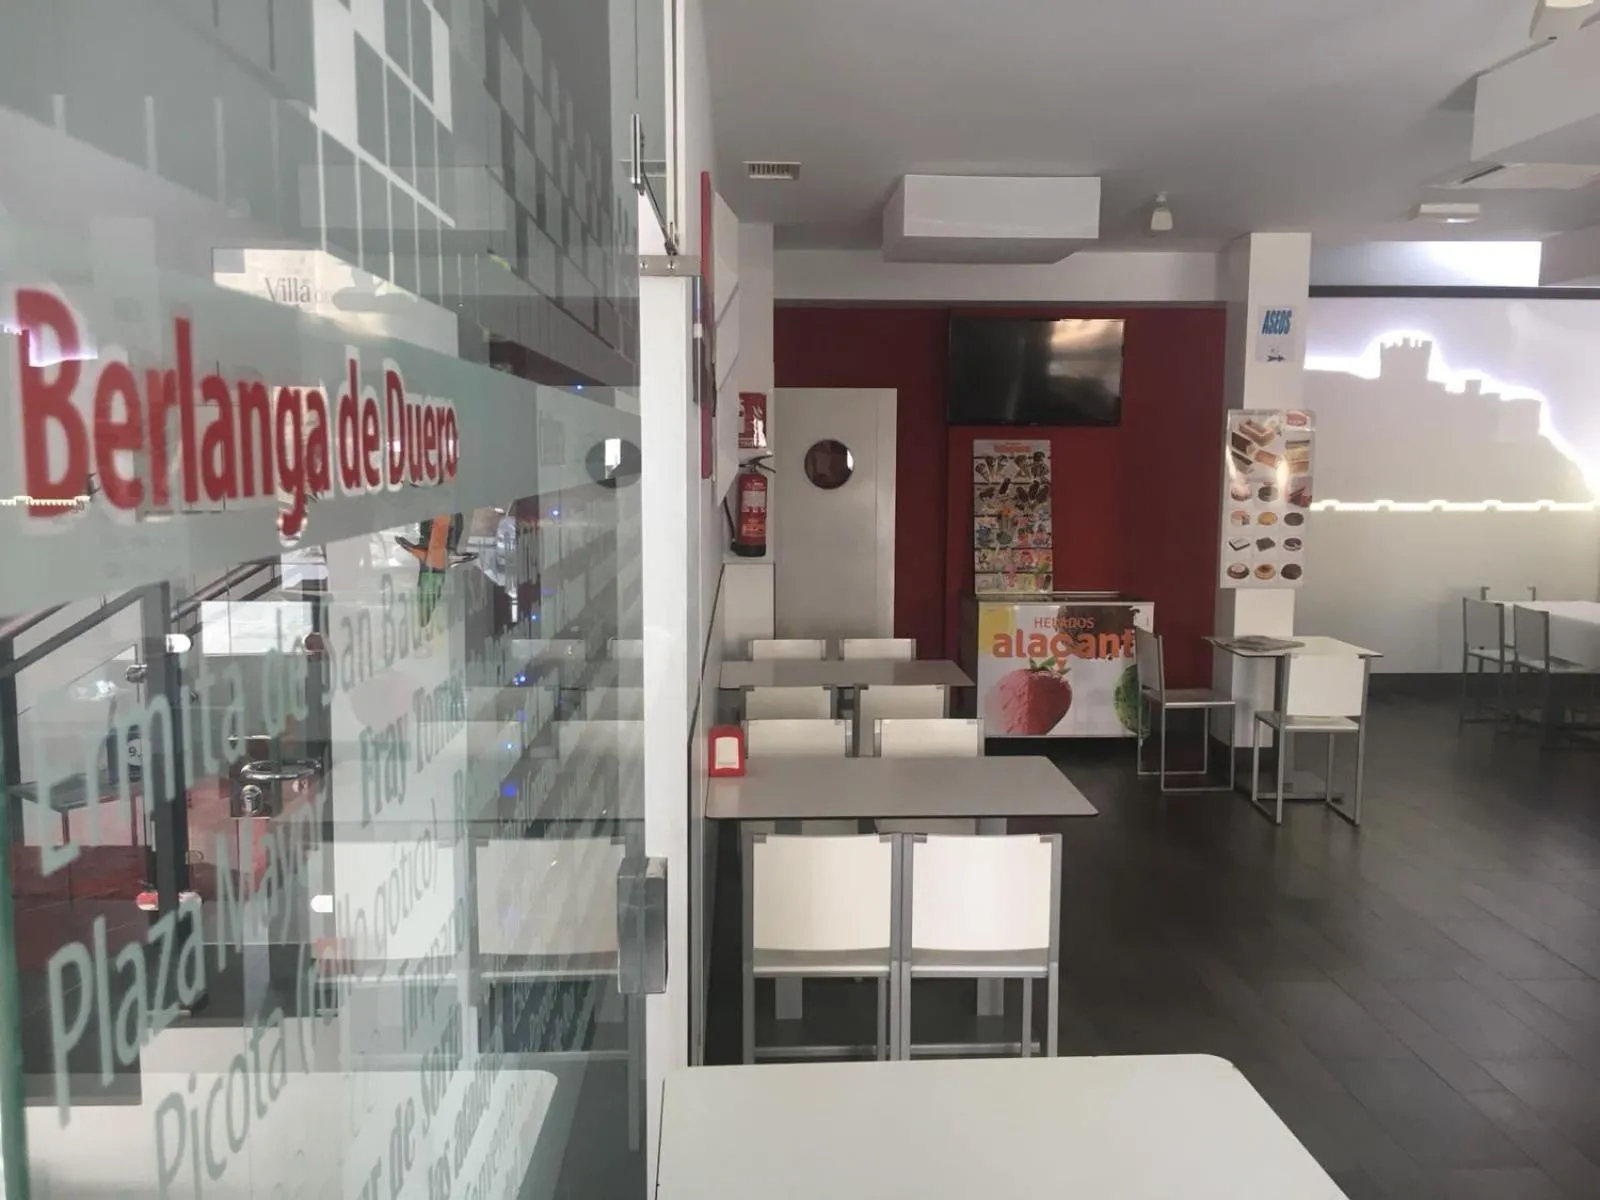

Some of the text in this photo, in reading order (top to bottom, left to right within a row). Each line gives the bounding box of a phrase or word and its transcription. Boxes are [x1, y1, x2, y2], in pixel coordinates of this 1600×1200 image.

[265, 277, 310, 304] Villa
[1261, 309, 1292, 335] ASEOS
[15, 288, 458, 537] Berlanga de Duero
[1034, 616, 1096, 629] HELADOS
[992, 628, 1136, 669] alaçant
[48, 895, 208, 1129] Plaza
[155, 1006, 288, 1200] Picota
